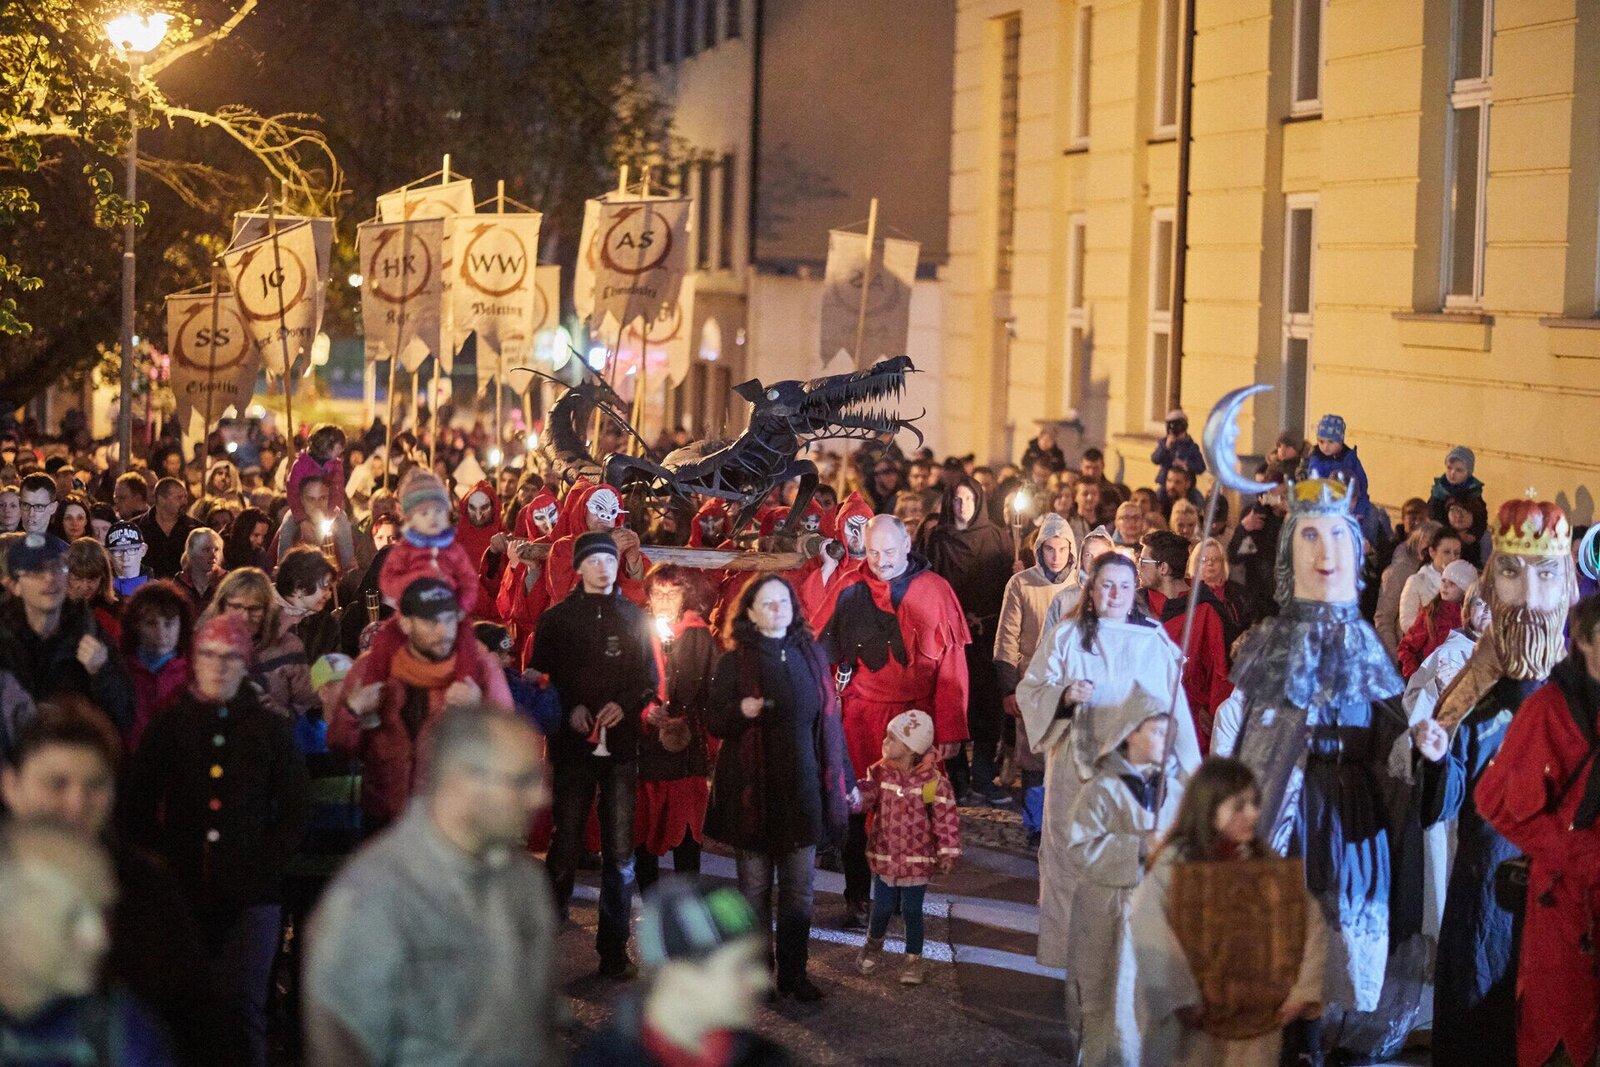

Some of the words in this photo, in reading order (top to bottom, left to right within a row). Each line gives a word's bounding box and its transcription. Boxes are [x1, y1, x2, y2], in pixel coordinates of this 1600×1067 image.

[616, 231, 655, 250] AS
[383, 254, 416, 279] HK
[470, 253, 525, 275] WW
[194, 327, 231, 348] SS
